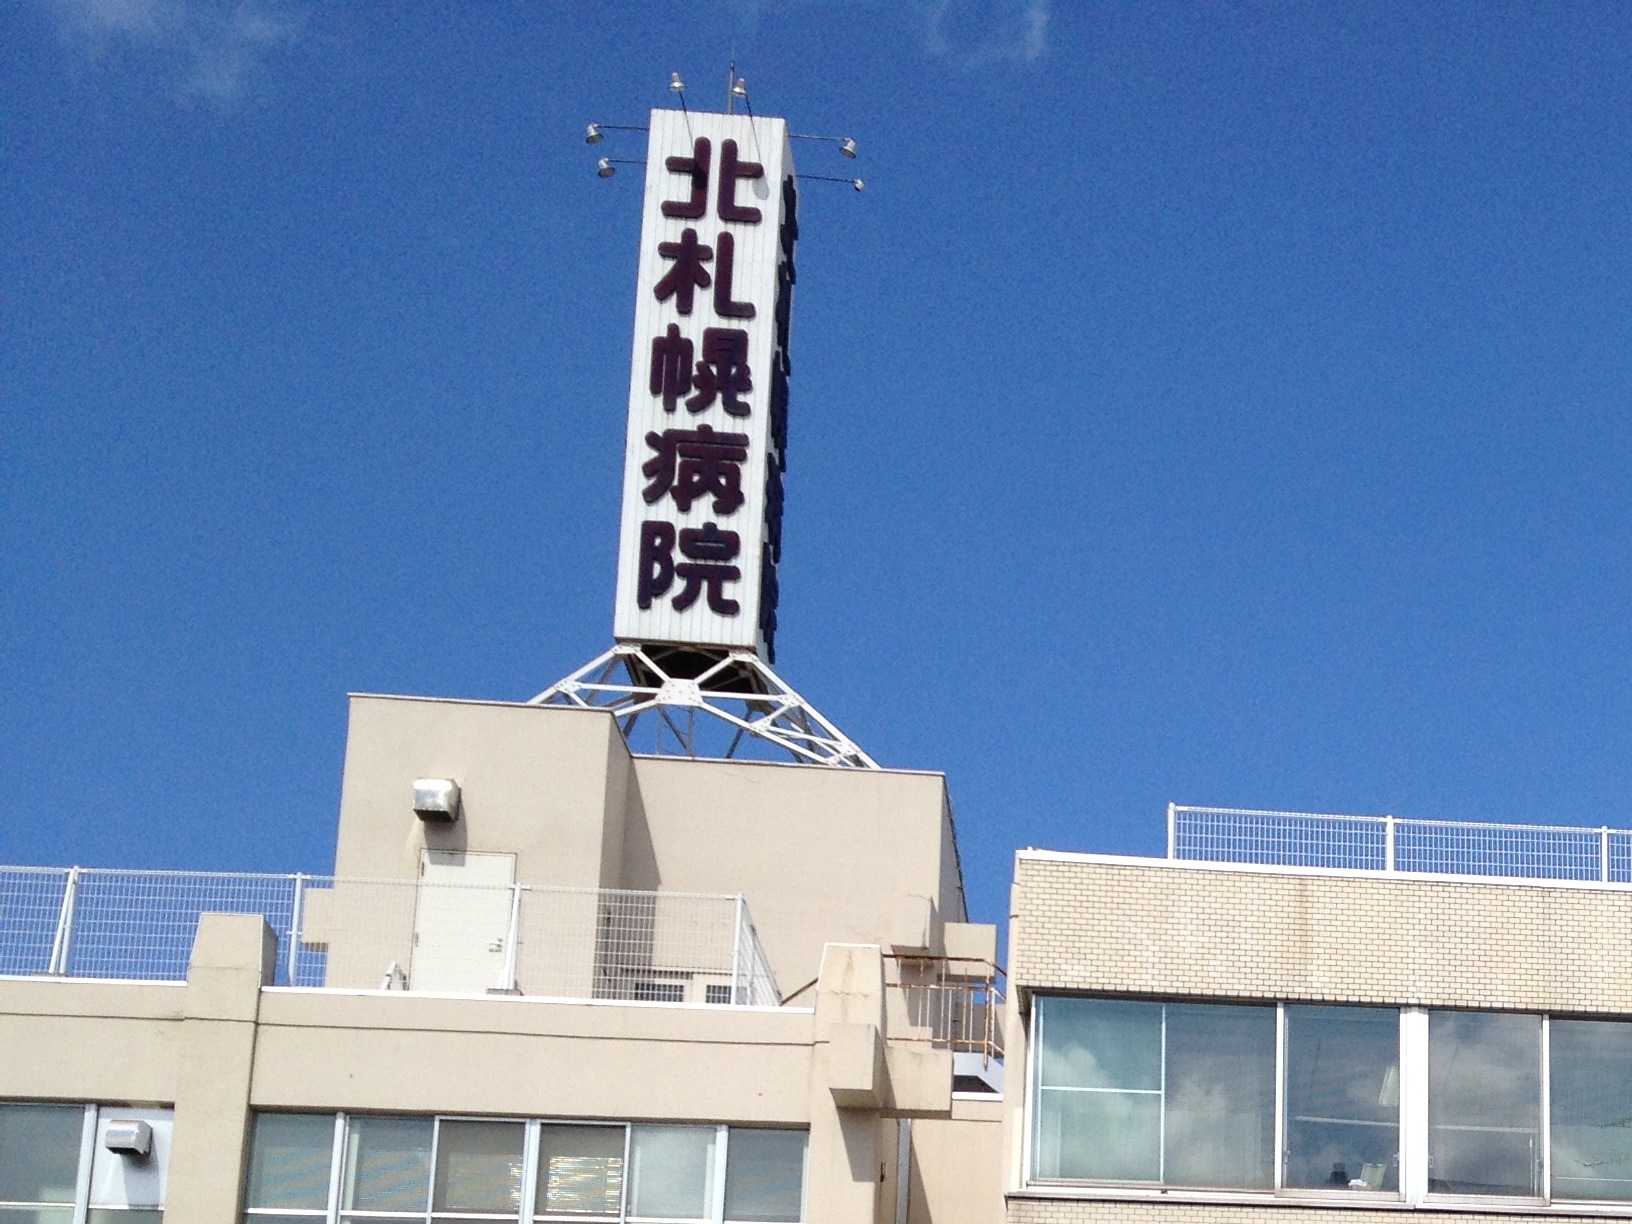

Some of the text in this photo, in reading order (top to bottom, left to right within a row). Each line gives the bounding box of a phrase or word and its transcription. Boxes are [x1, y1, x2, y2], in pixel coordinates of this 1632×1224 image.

[637, 136, 764, 617] 北札幌病院
